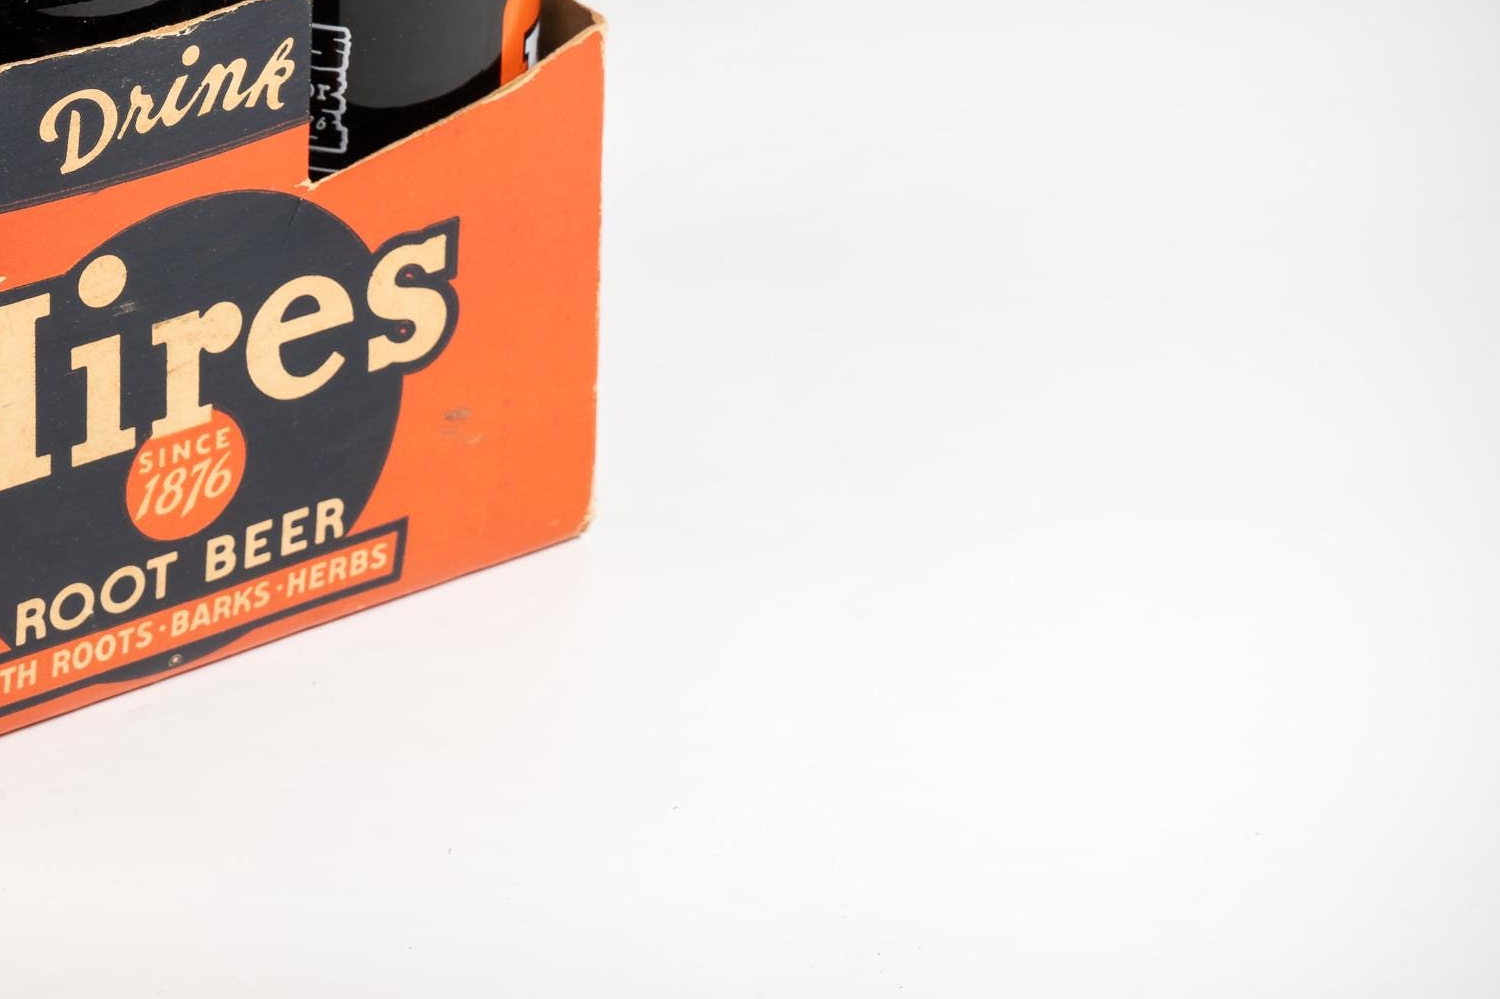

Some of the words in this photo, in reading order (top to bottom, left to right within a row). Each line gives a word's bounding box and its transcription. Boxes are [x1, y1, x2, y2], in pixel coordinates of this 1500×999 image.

[40, 37, 295, 176] Drink
[135, 452, 232, 523] 1876
[138, 427, 231, 474] SINCE
[15, 550, 179, 647] ROOT
[205, 497, 346, 583] BEER
